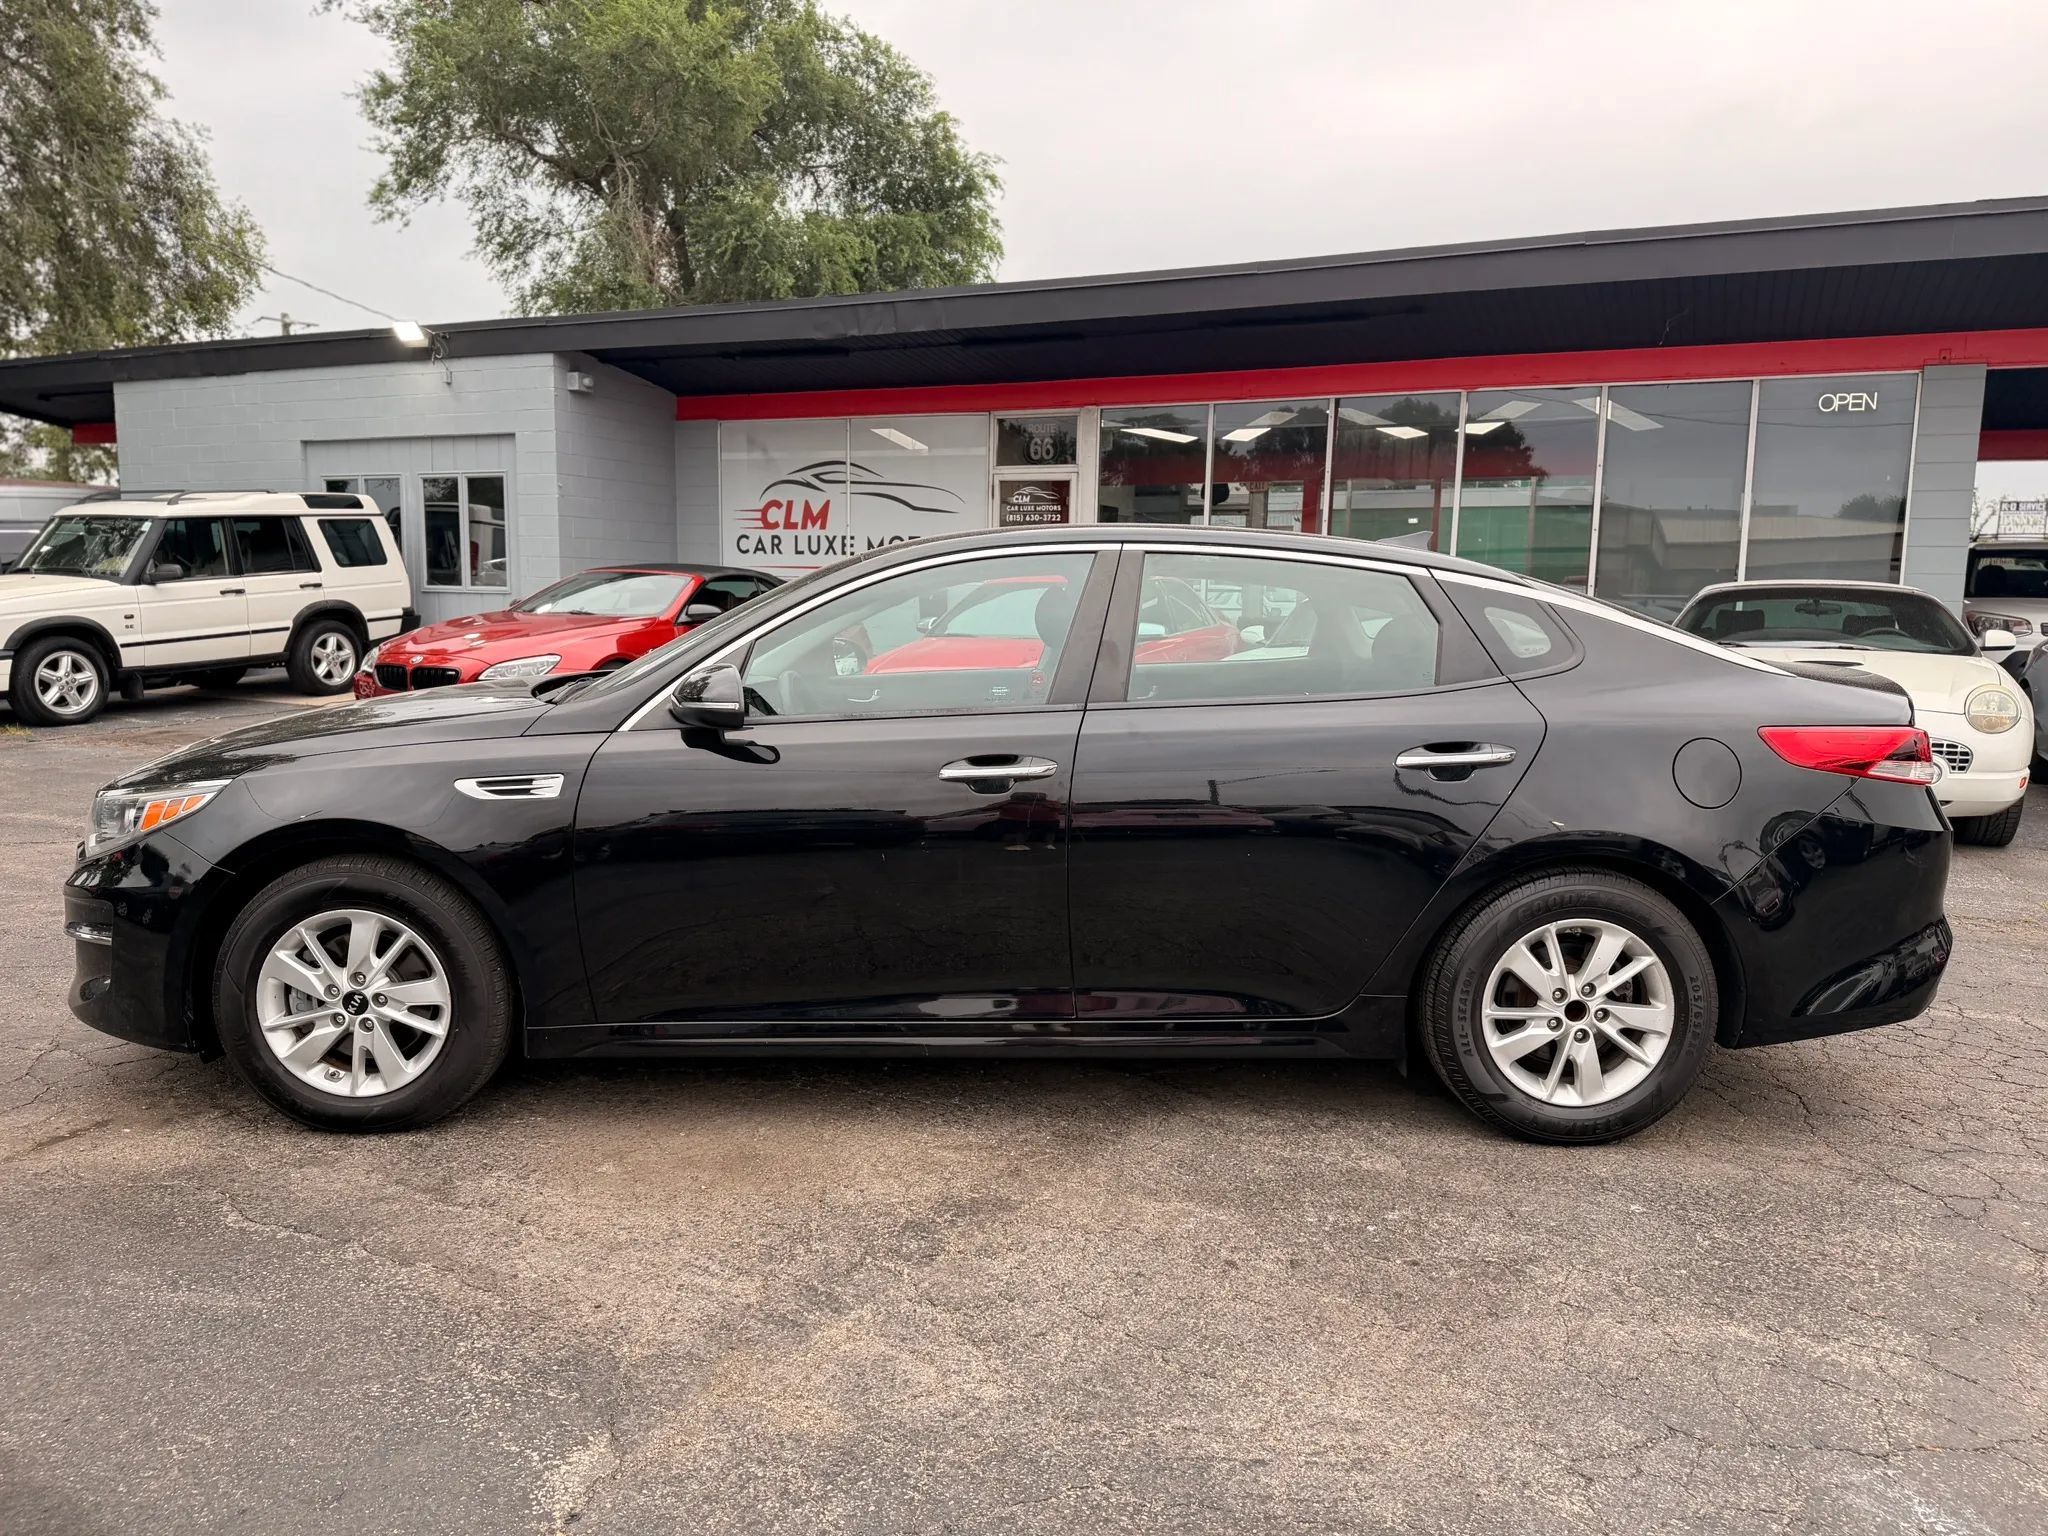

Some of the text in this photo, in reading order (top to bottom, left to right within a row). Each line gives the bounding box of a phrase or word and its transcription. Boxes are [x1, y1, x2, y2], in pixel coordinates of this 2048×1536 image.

[1818, 391, 1878, 413] OPEN
[1028, 423, 1057, 434] ROUTE
[1029, 437, 1055, 460] 66
[1013, 495, 1031, 503] CLM
[760, 499, 831, 530] CLM
[1006, 513, 1062, 522] (815) 630-3722
[736, 534, 783, 555] CAR
[795, 535, 855, 555] LUXE
[347, 994, 364, 1014] KIA
[1458, 967, 1477, 1057] ALL-SEASON
